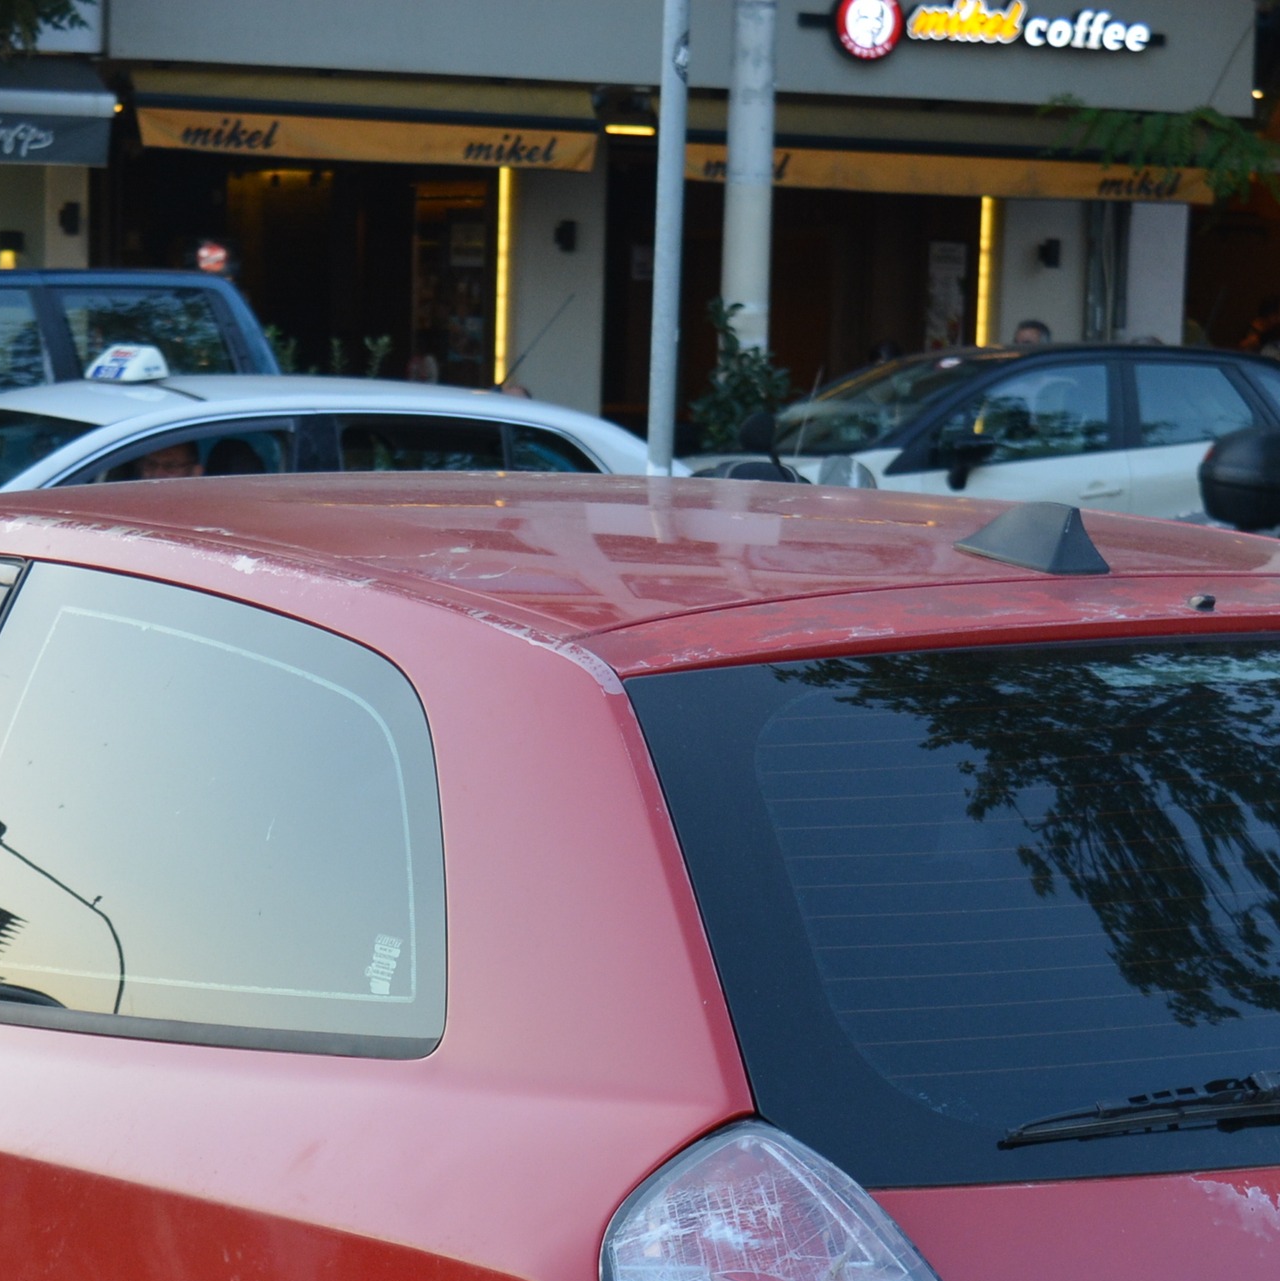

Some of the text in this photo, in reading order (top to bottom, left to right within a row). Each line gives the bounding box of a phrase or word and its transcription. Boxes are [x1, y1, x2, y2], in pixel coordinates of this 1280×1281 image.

[909, 0, 1150, 51] mikel coffee
[181, 118, 280, 150] mikel
[463, 134, 558, 164] mikel
[1098, 169, 1183, 198] mikel
